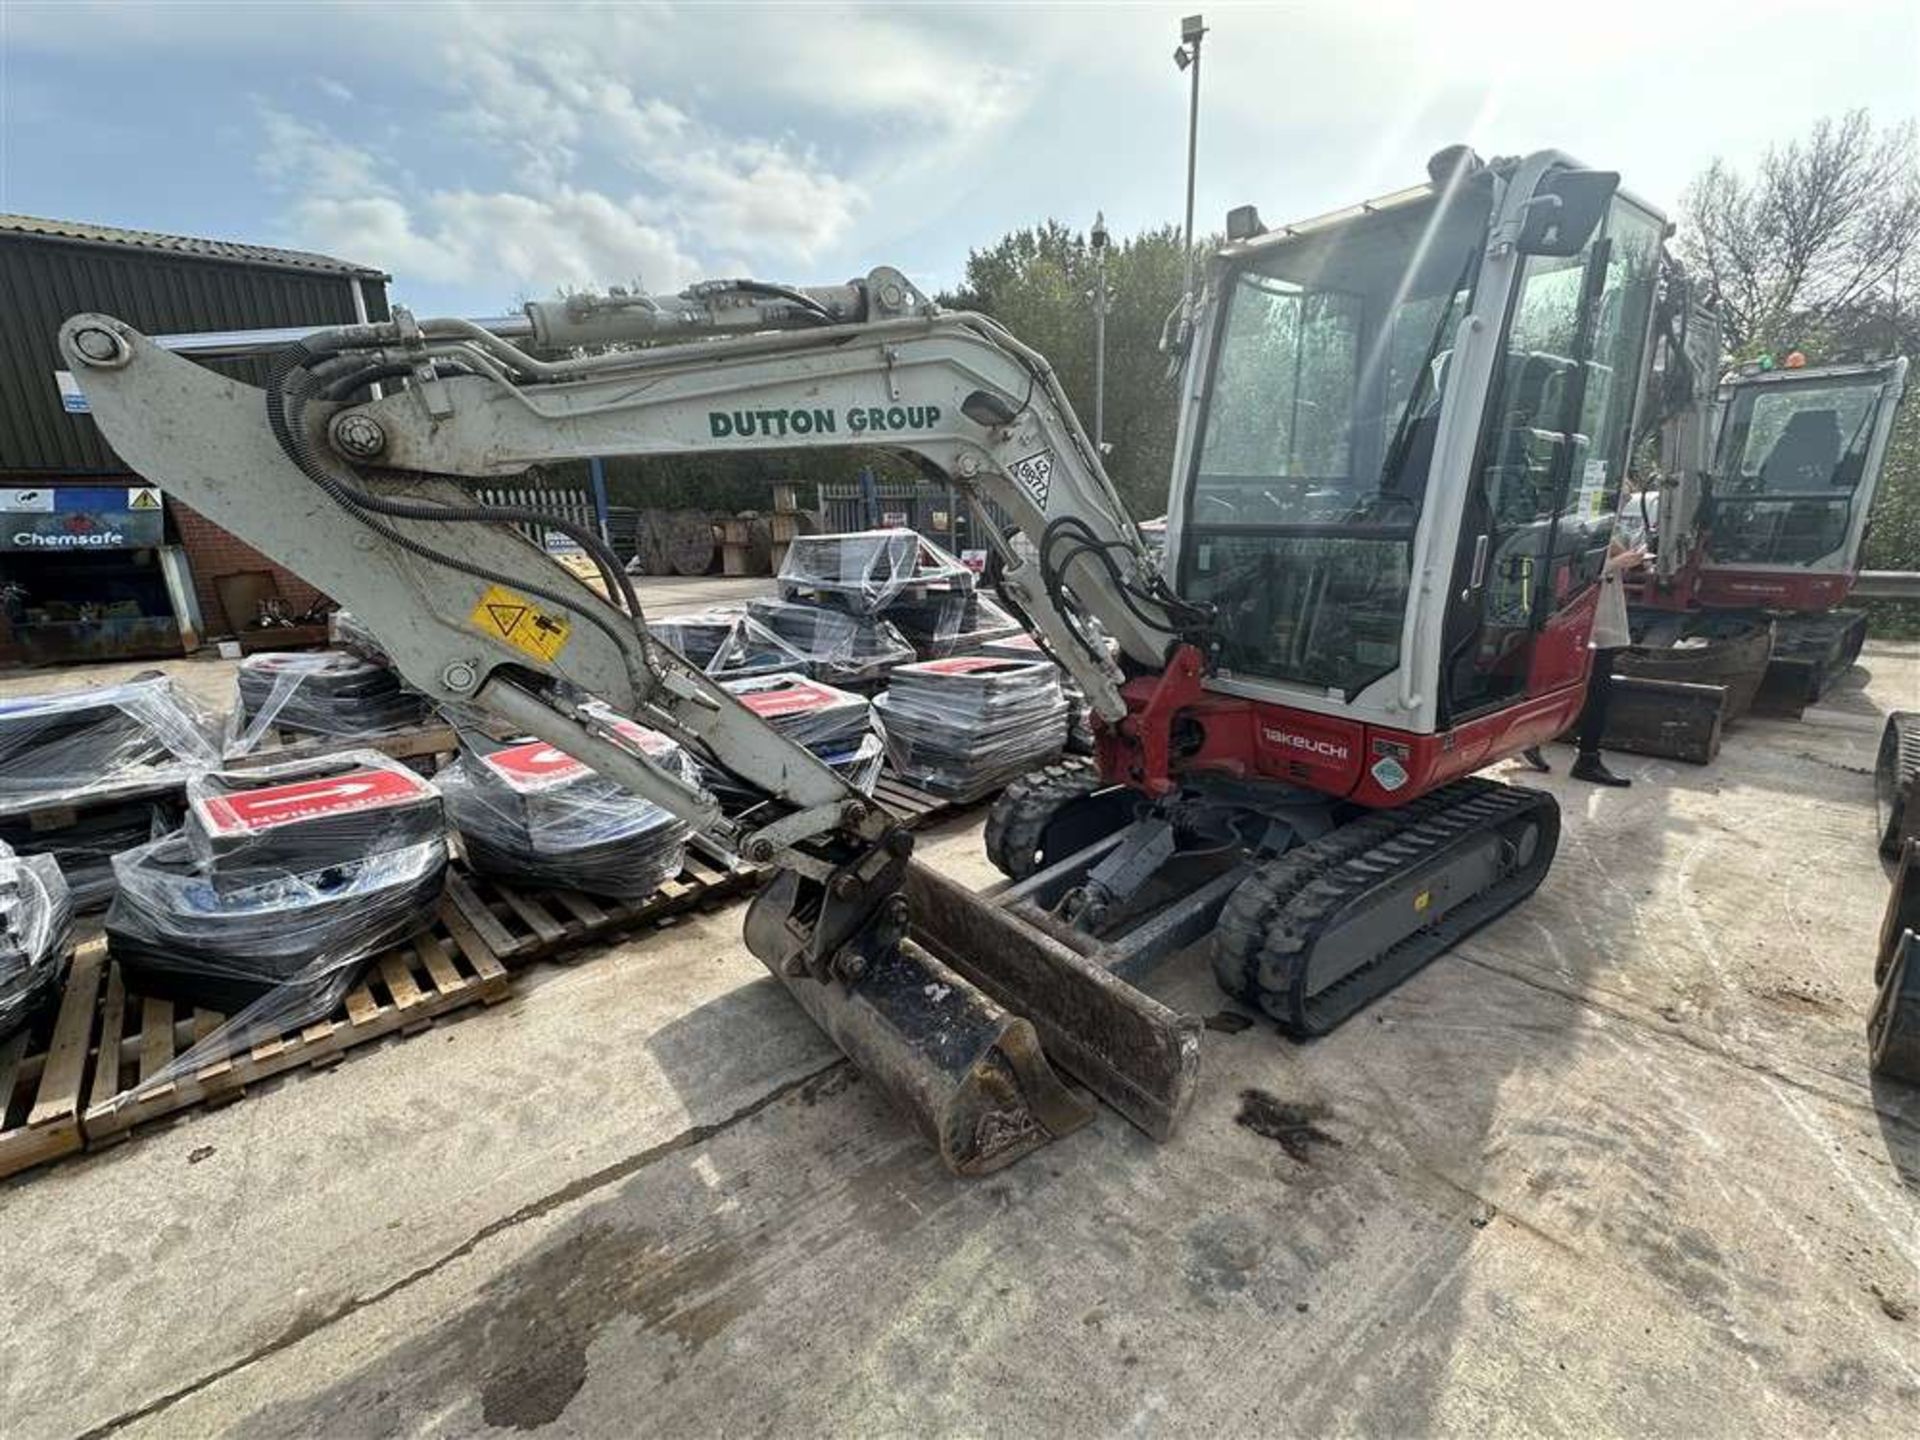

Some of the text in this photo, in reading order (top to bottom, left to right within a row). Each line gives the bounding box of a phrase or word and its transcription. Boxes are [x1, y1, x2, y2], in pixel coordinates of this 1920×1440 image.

[708, 406, 941, 438] DUTTON GROUP
[13, 532, 124, 546] Chemsafe
